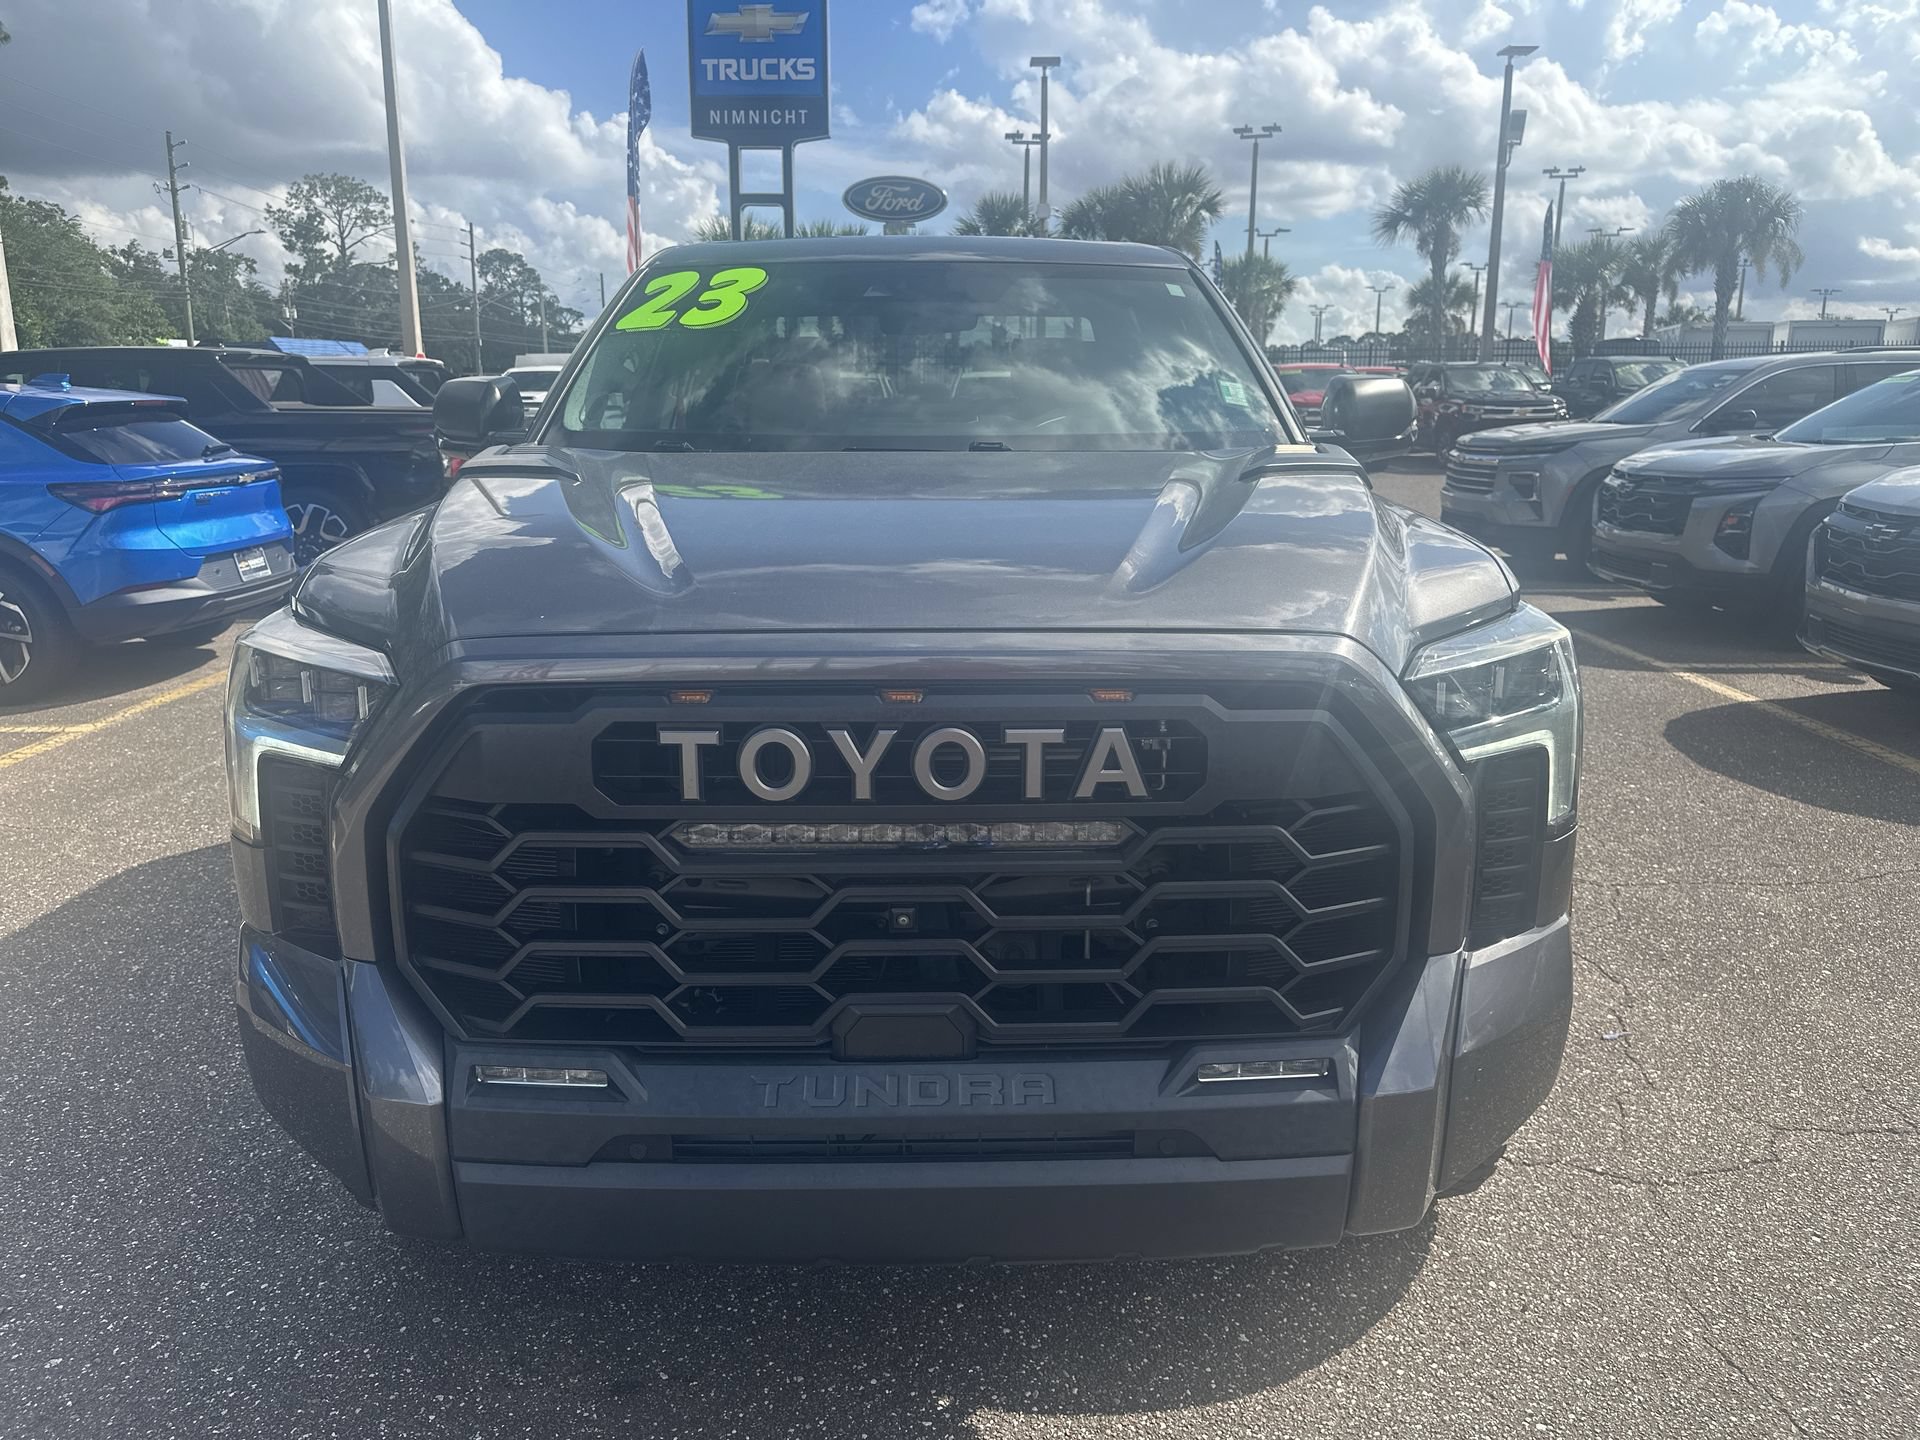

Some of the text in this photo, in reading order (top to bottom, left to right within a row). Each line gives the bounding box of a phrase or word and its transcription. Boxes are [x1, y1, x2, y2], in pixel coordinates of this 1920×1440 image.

[700, 57, 816, 81] TRUCKS
[709, 109, 809, 125] NIMNICHT
[864, 184, 926, 212] Ford
[615, 267, 769, 332] 23
[659, 726, 1149, 801] TOYOTA
[750, 1072, 1057, 1108] TUNDRA
